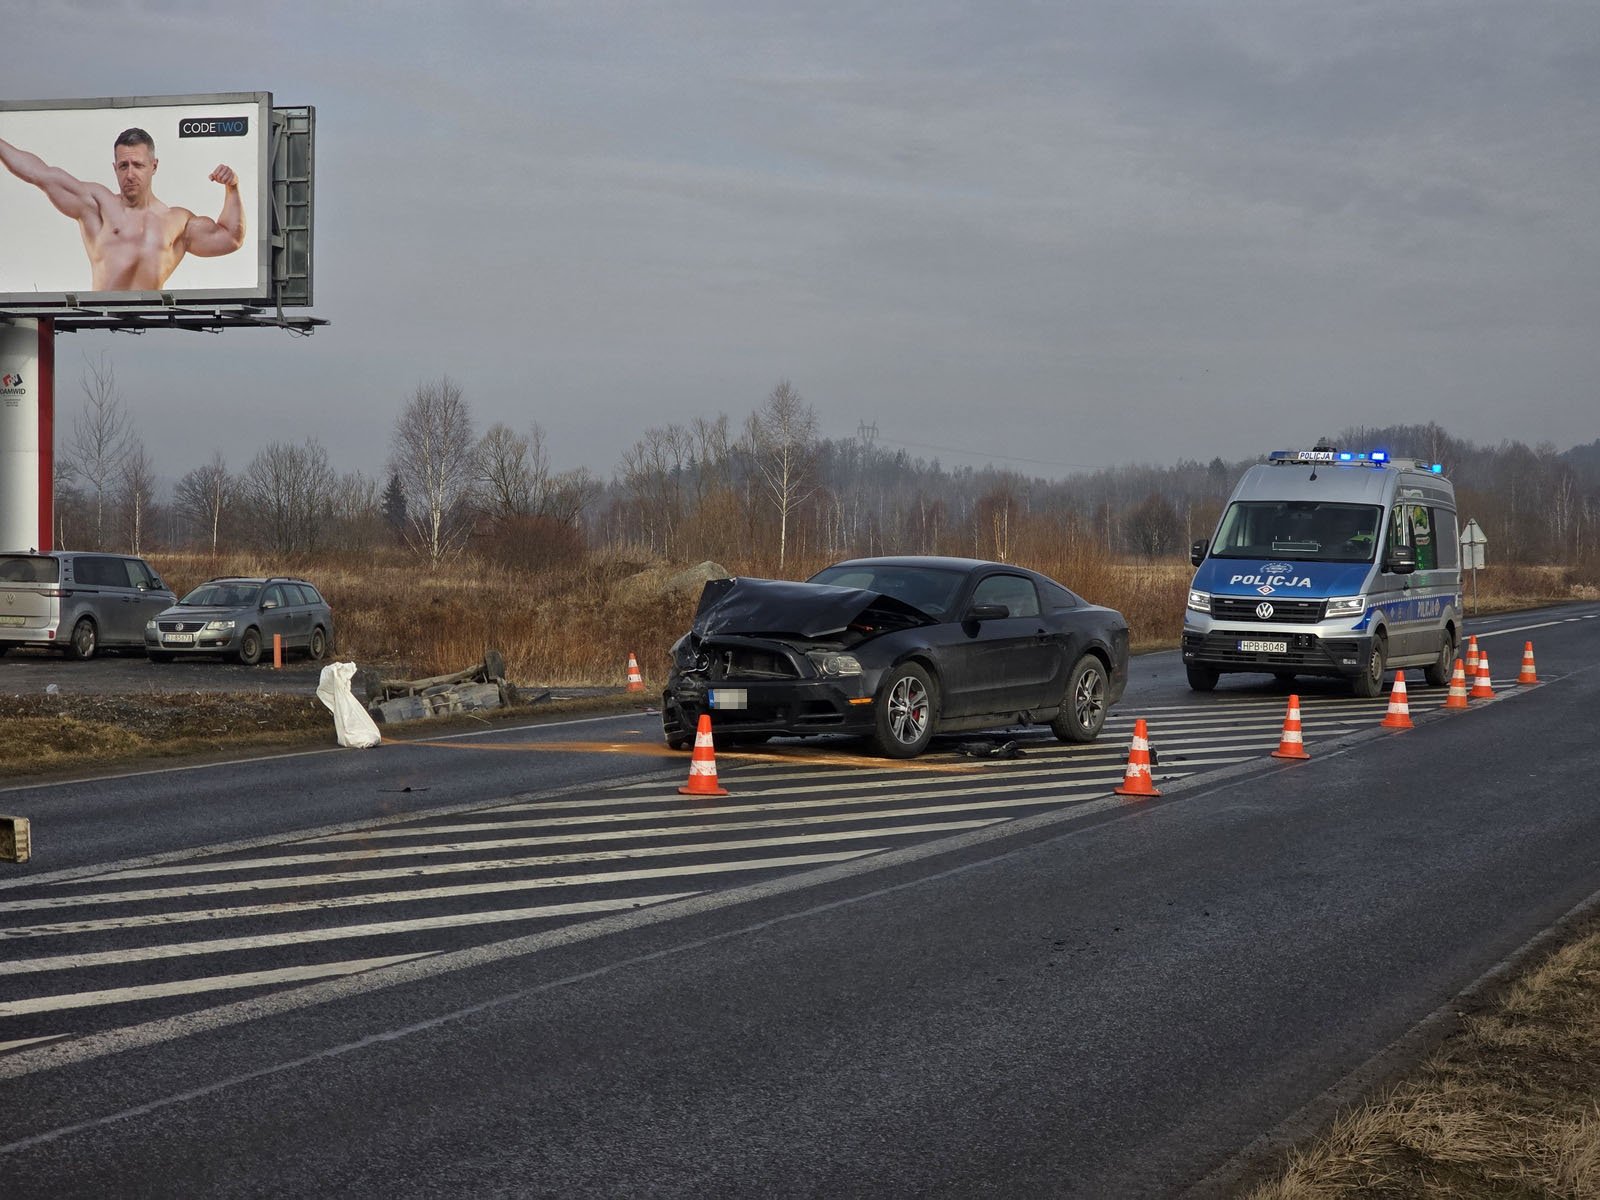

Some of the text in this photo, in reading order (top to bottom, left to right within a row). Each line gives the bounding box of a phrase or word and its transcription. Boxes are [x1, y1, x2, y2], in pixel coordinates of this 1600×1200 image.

[183, 121, 243, 133] CODETWO
[1300, 452, 1330, 460] POLICJA
[1229, 575, 1312, 588] POLICJA
